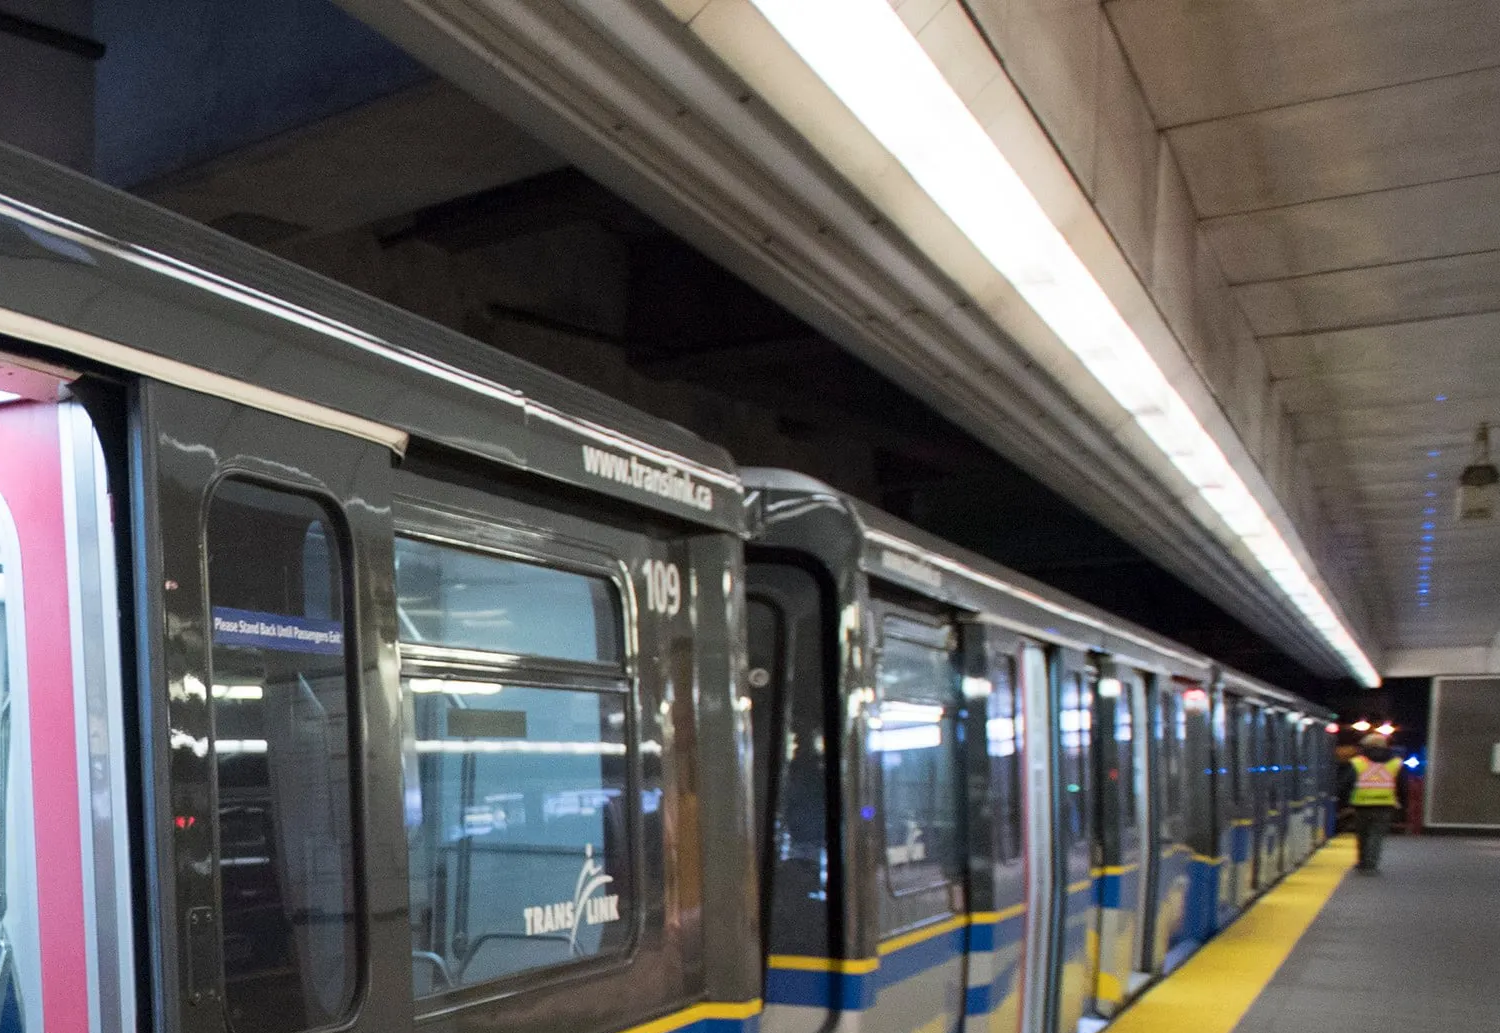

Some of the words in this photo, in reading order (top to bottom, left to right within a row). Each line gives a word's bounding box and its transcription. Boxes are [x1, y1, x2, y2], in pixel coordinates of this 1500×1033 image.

[642, 559, 681, 615] 109
[214, 616, 238, 633] Please
[239, 620, 260, 635] Stand
[260, 622, 277, 637] Back
